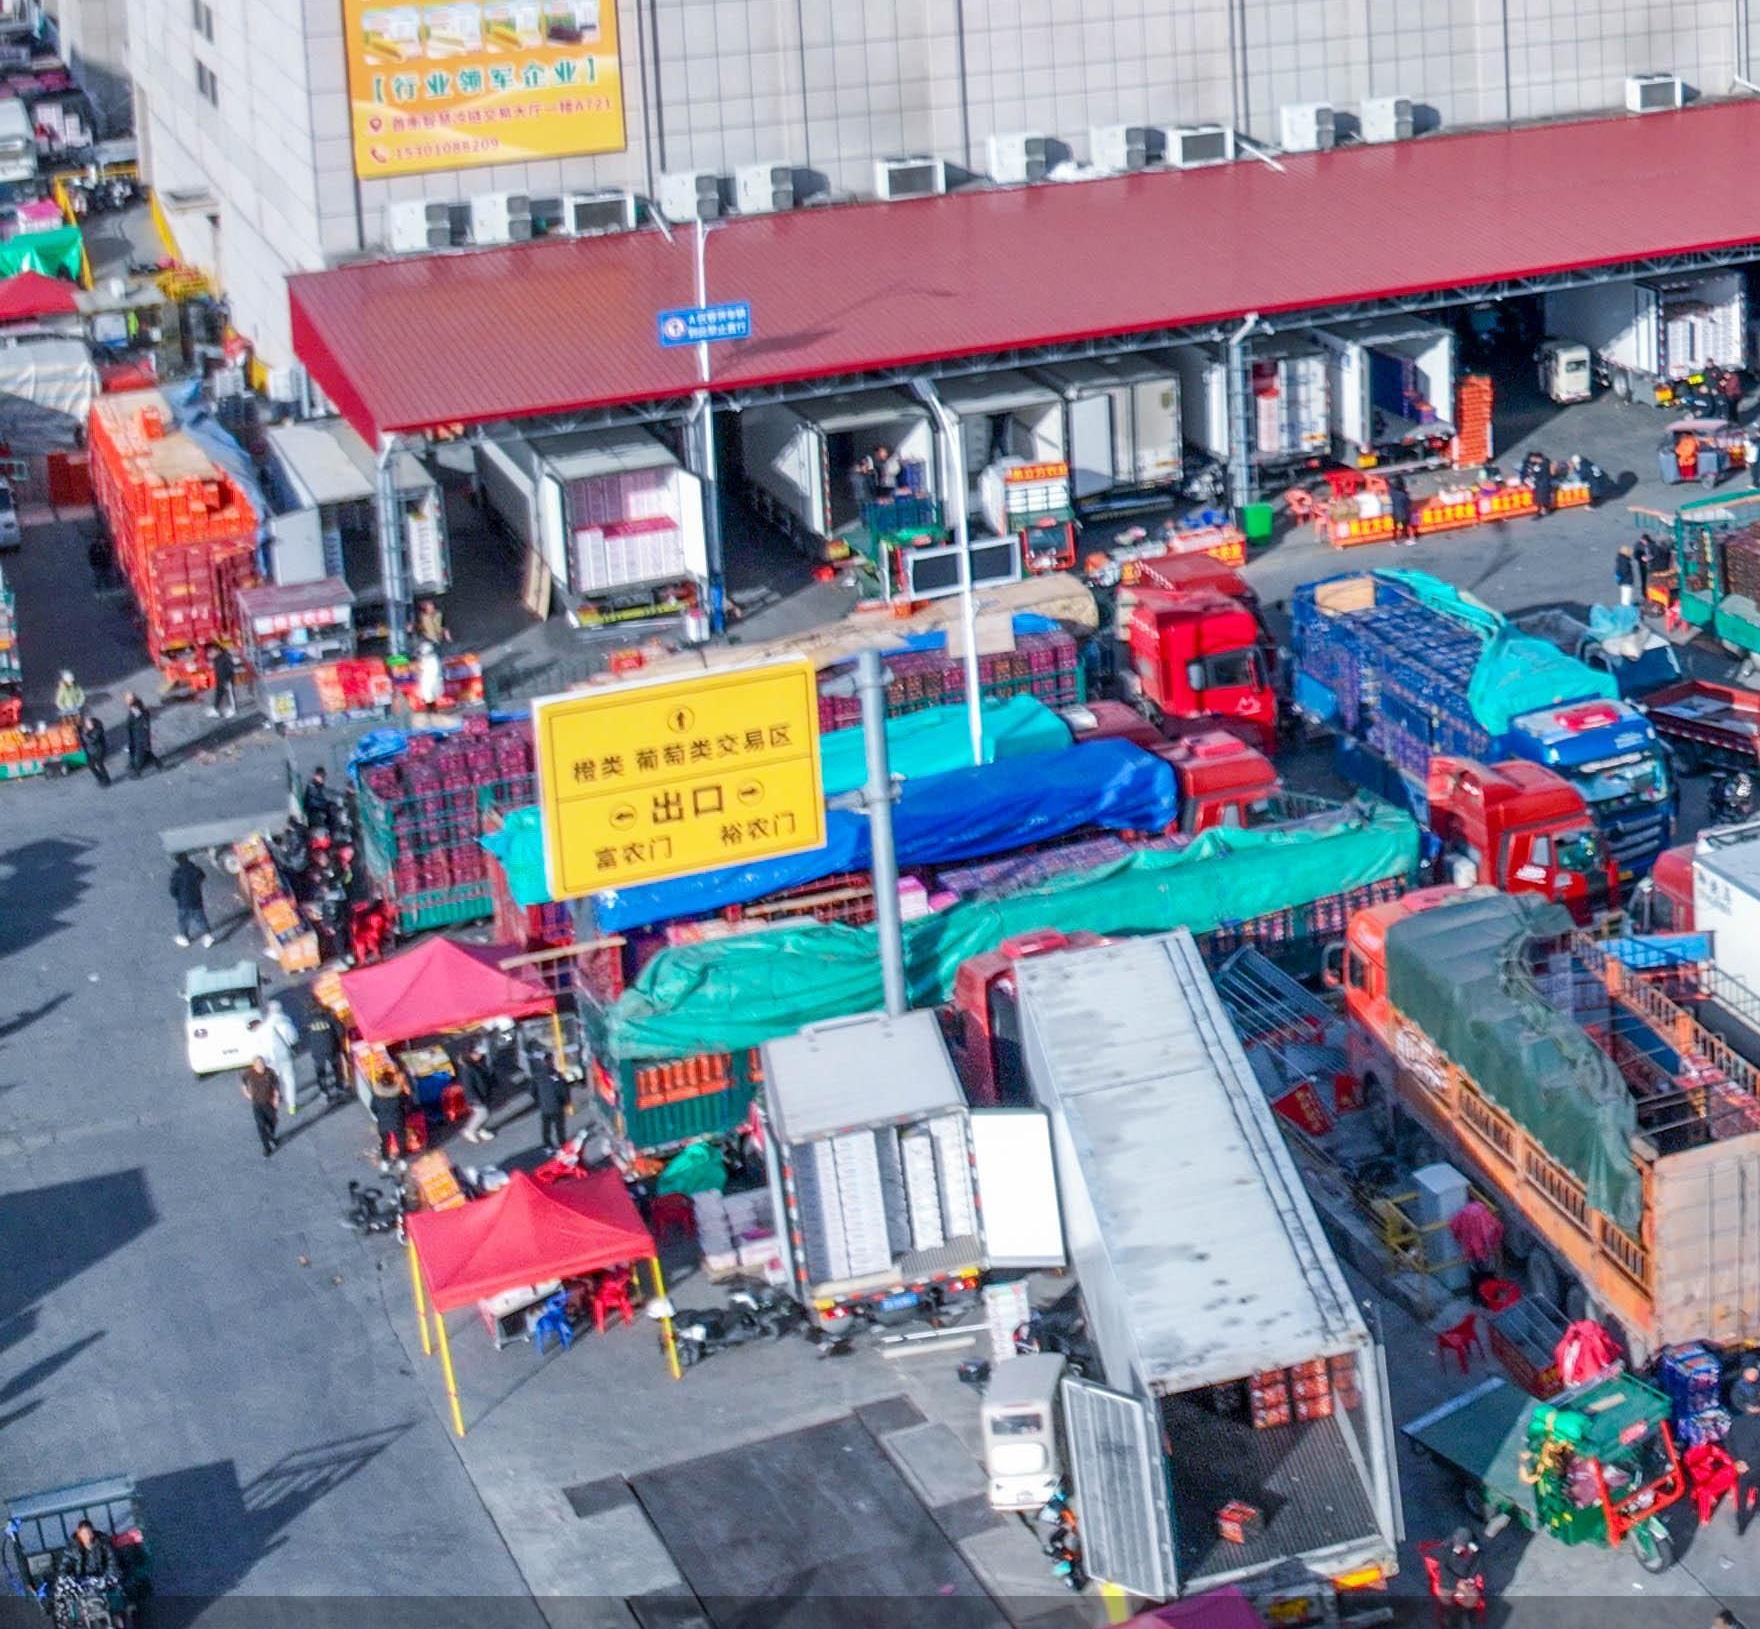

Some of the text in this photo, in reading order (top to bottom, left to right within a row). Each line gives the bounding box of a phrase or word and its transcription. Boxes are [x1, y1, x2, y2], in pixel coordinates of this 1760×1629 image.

[571, 723, 793, 784] 橙类 葡萄类交易区
[651, 783, 725, 825] 出口
[594, 812, 796, 872] 富农门 裕农门
